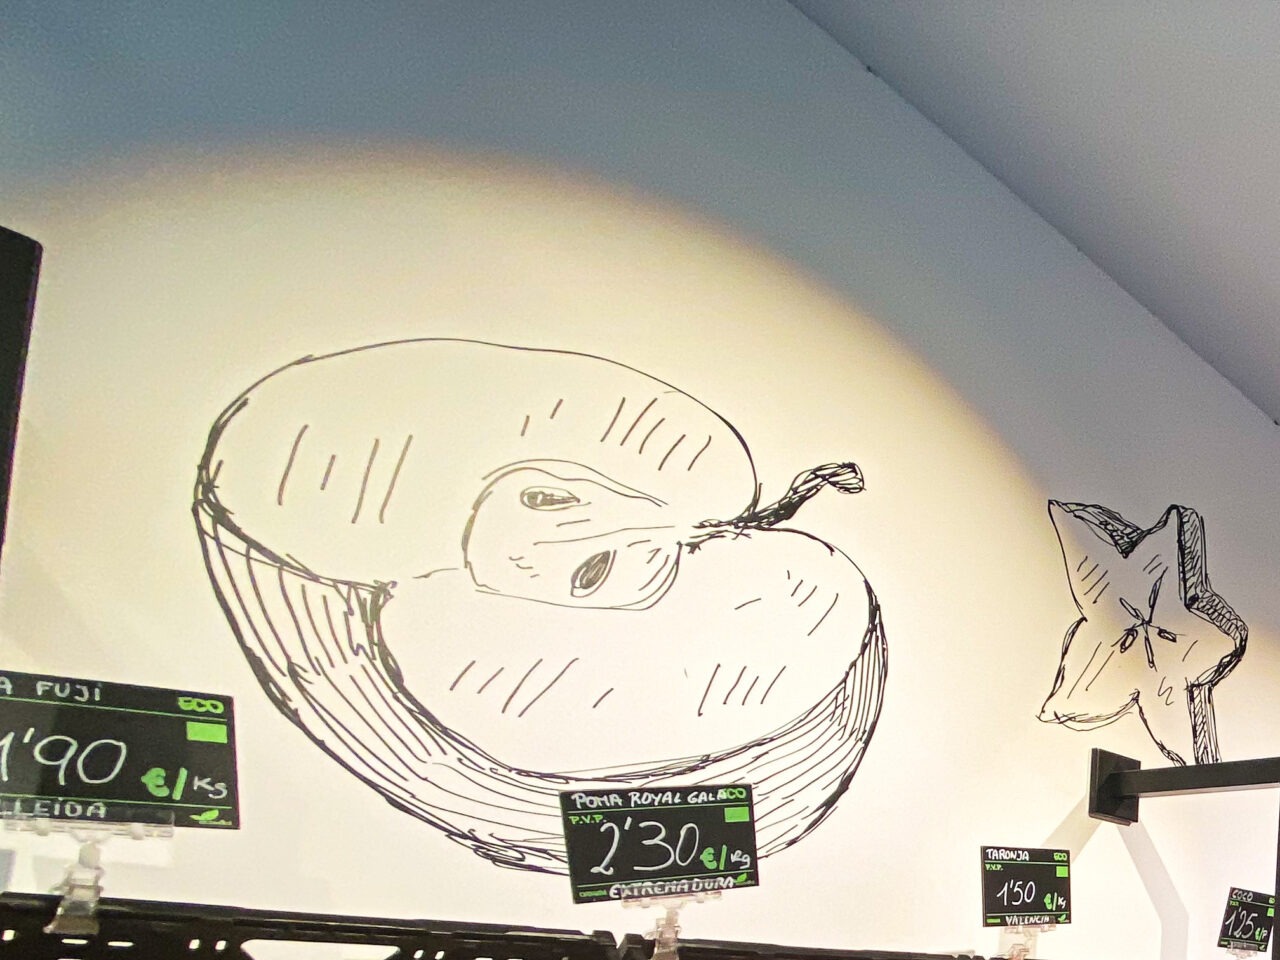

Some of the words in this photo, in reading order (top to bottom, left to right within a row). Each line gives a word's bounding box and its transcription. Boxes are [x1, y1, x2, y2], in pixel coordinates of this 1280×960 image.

[36, 680, 101, 701] FUJI
[572, 792, 623, 808] POMA
[628, 791, 682, 806] ROYAL
[569, 814, 607, 824] P.V.P.
[590, 816, 699, 875] 2'30
[985, 848, 1030, 861] TARONJA
[609, 876, 734, 898] EXTREMADURA
[996, 879, 1036, 906] 1'50
